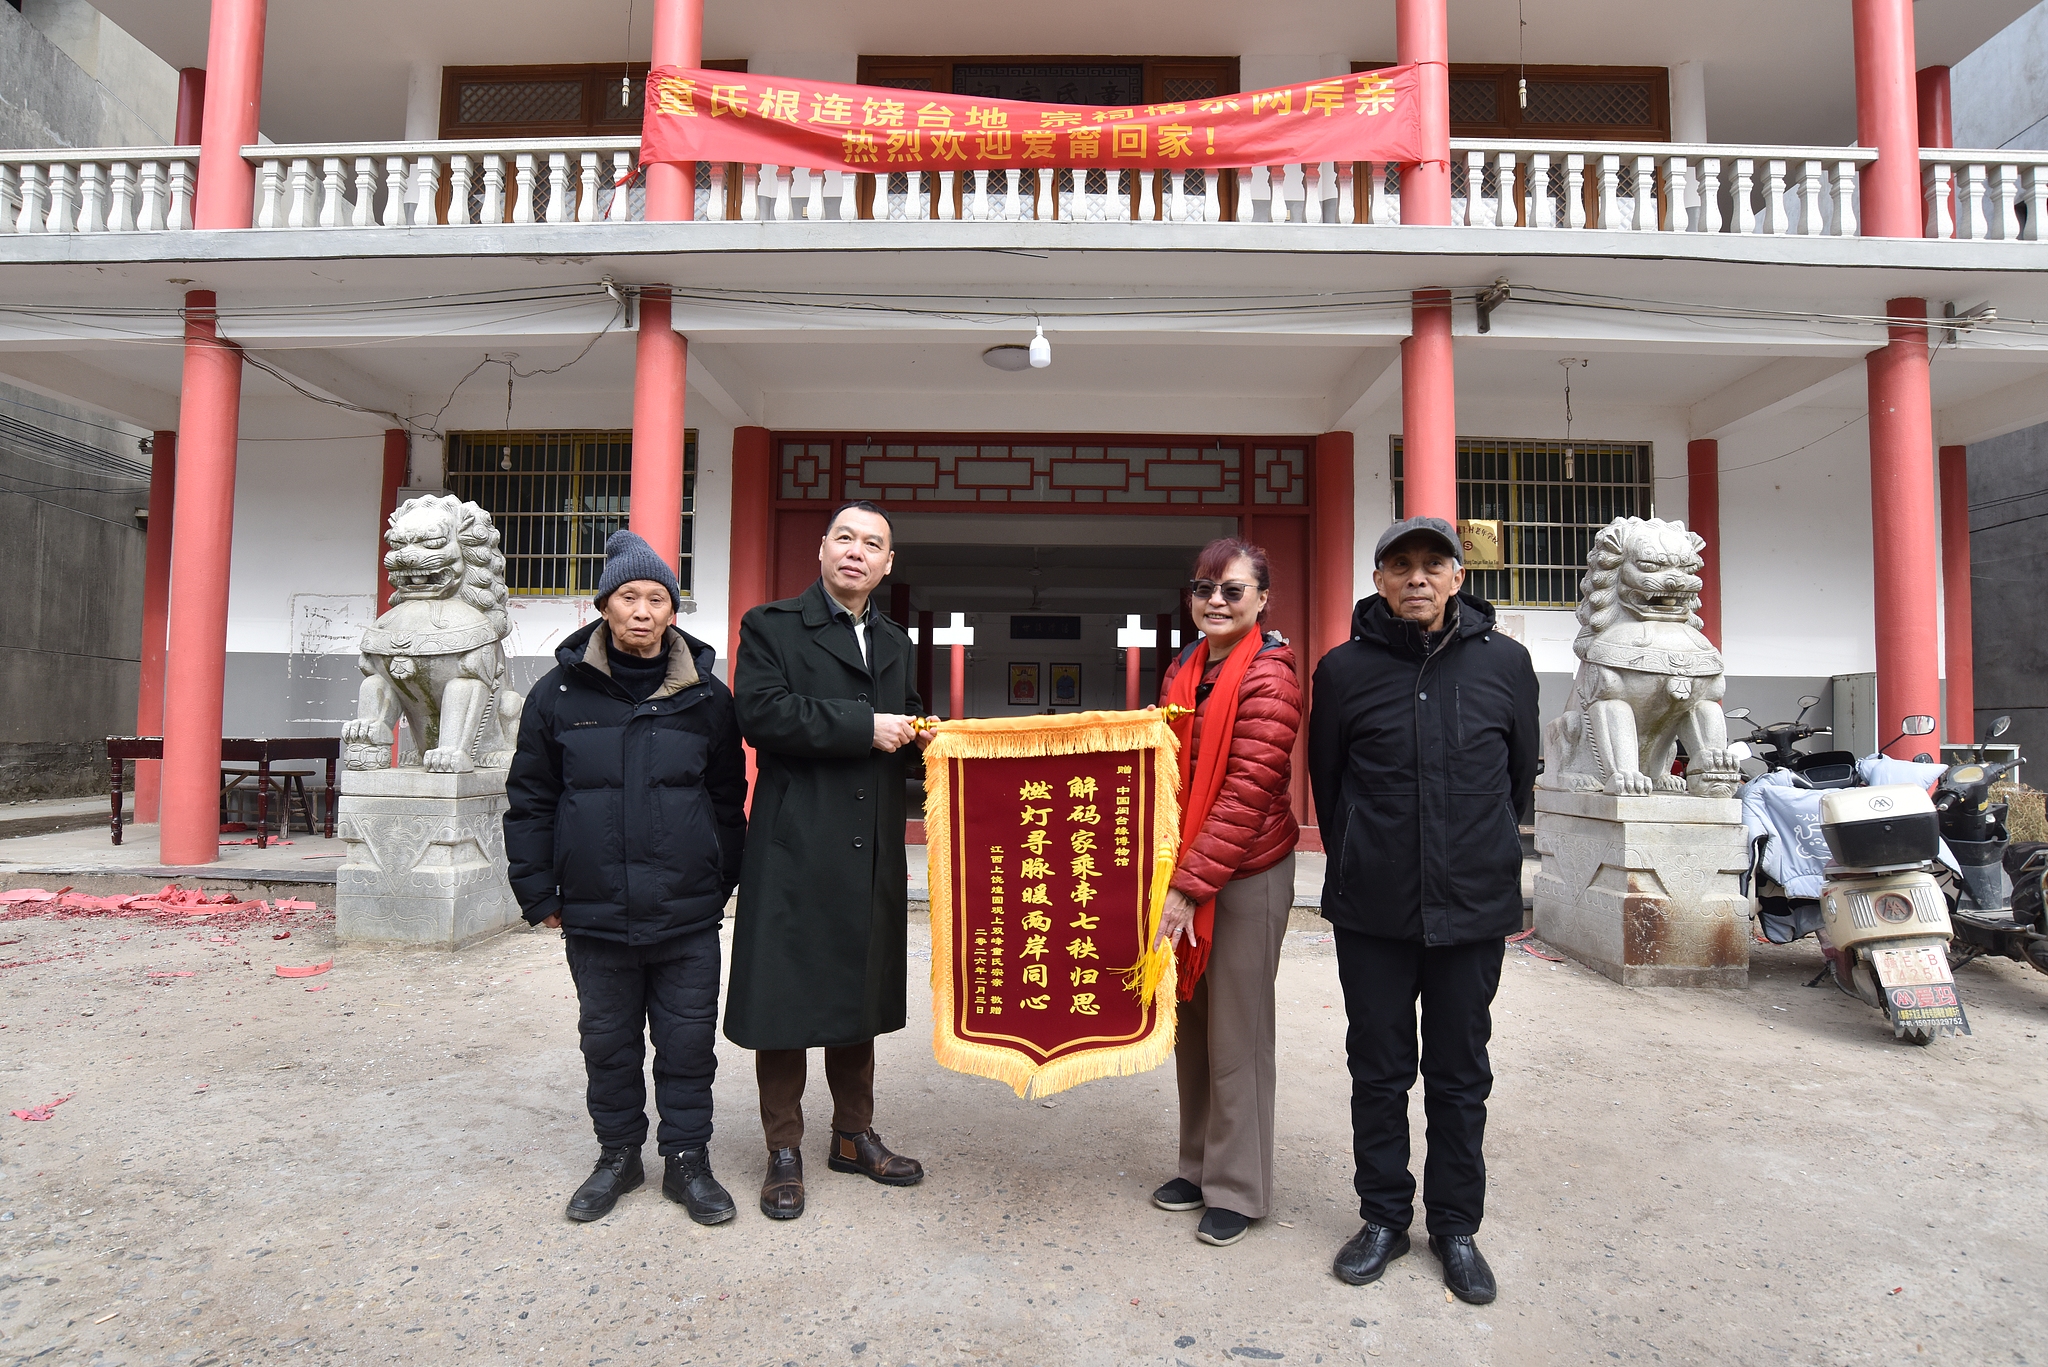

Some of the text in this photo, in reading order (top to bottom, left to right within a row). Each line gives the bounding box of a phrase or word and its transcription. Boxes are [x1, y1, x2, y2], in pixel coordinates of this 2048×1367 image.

[656, 76, 1009, 129] 童氏根连饶台地
[1019, 779, 1056, 1010] 燃灯寻脉暖两岸同心
[1065, 776, 1103, 1016] 解码家乘牵七秩归思
[974, 928, 988, 1014] 二零二六年二月三日
[1884, 967, 1945, 983] T4251
[1915, 985, 1958, 1008] 爱玛
